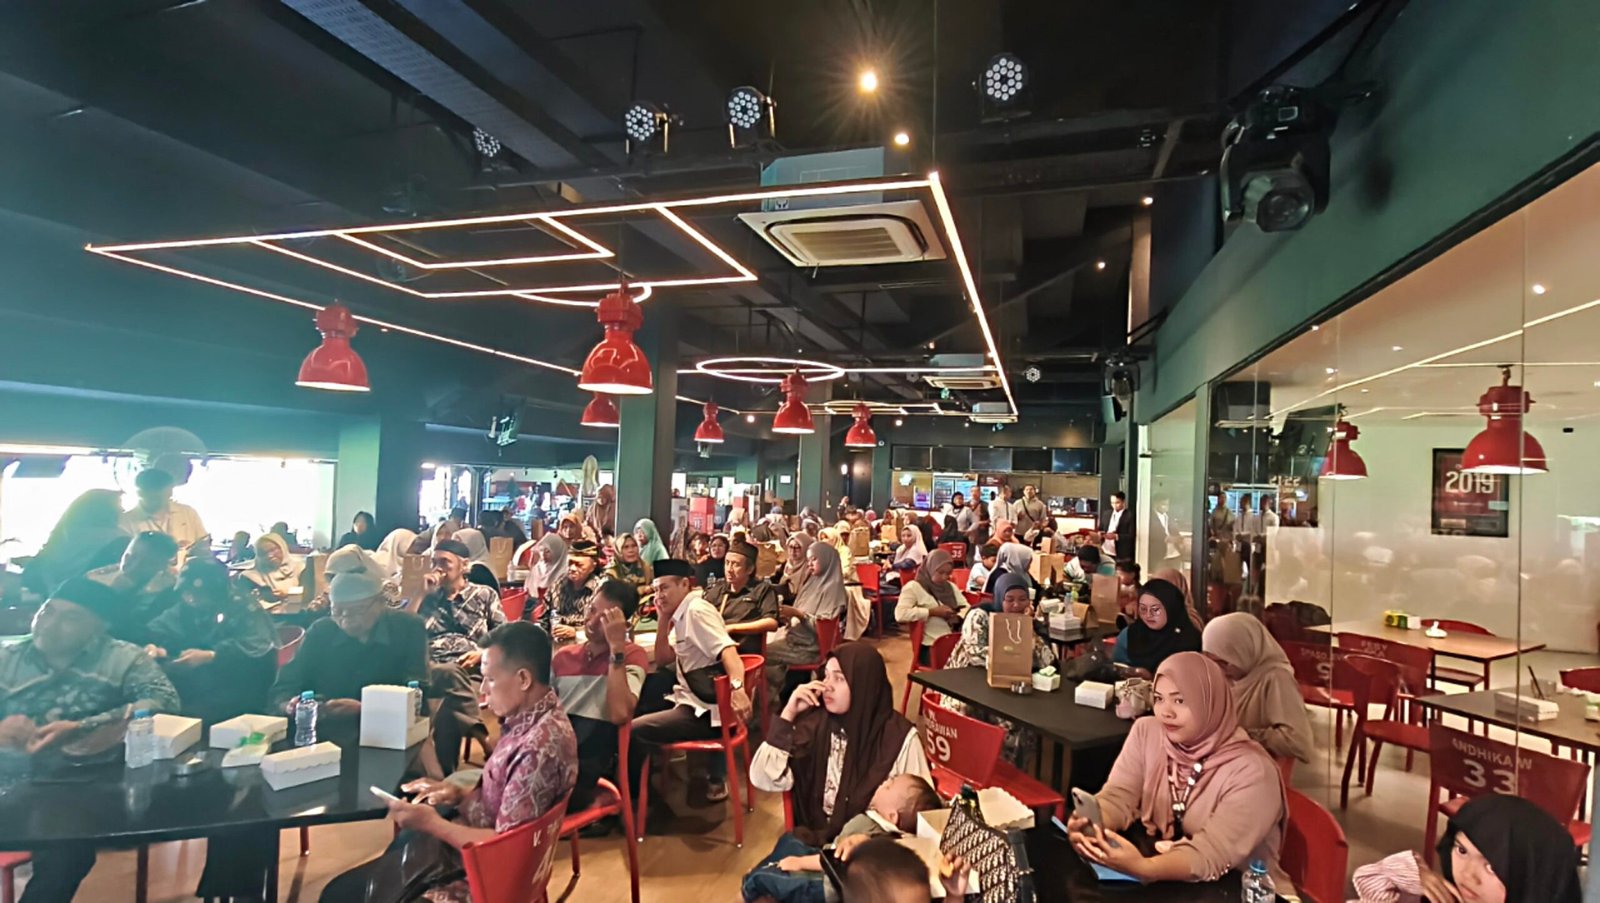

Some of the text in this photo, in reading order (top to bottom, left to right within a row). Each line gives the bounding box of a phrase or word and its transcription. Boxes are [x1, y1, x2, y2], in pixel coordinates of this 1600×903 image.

[1445, 471, 1494, 494] 2019
[925, 728, 951, 762] 59
[1452, 738, 1513, 768] ANDHIKA
[1463, 758, 1517, 795] 33
